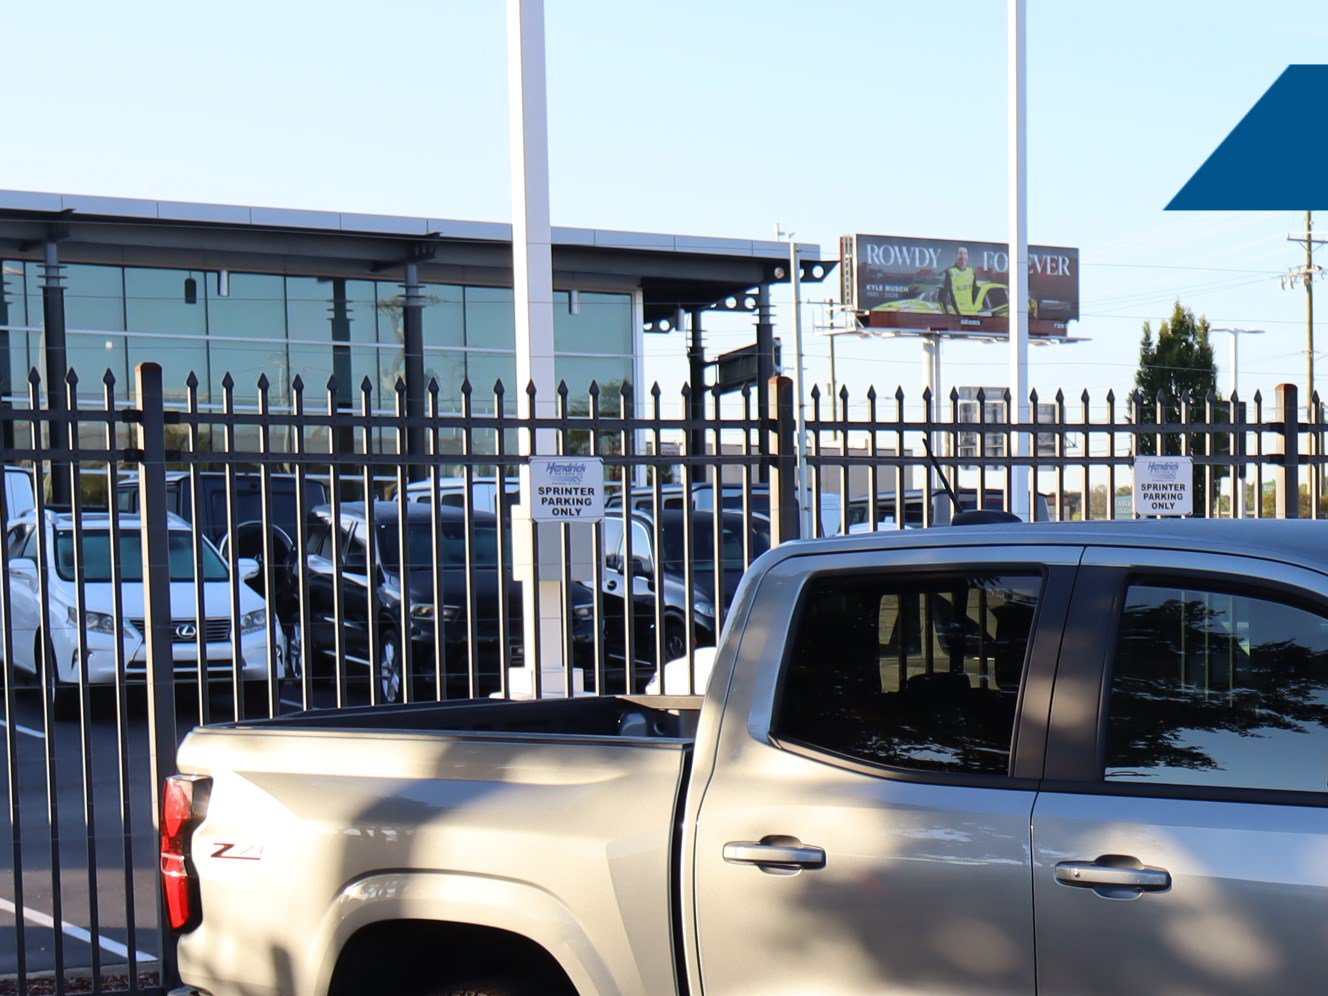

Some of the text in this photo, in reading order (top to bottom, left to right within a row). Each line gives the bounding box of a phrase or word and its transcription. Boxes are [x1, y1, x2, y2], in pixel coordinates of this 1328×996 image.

[866, 244, 1070, 276] ROWDY FOEVER
[546, 462, 587, 475] Hendrick
[538, 487, 595, 495] SPRINTER
[541, 497, 592, 506] PARKING
[552, 508, 582, 516] ONLY
